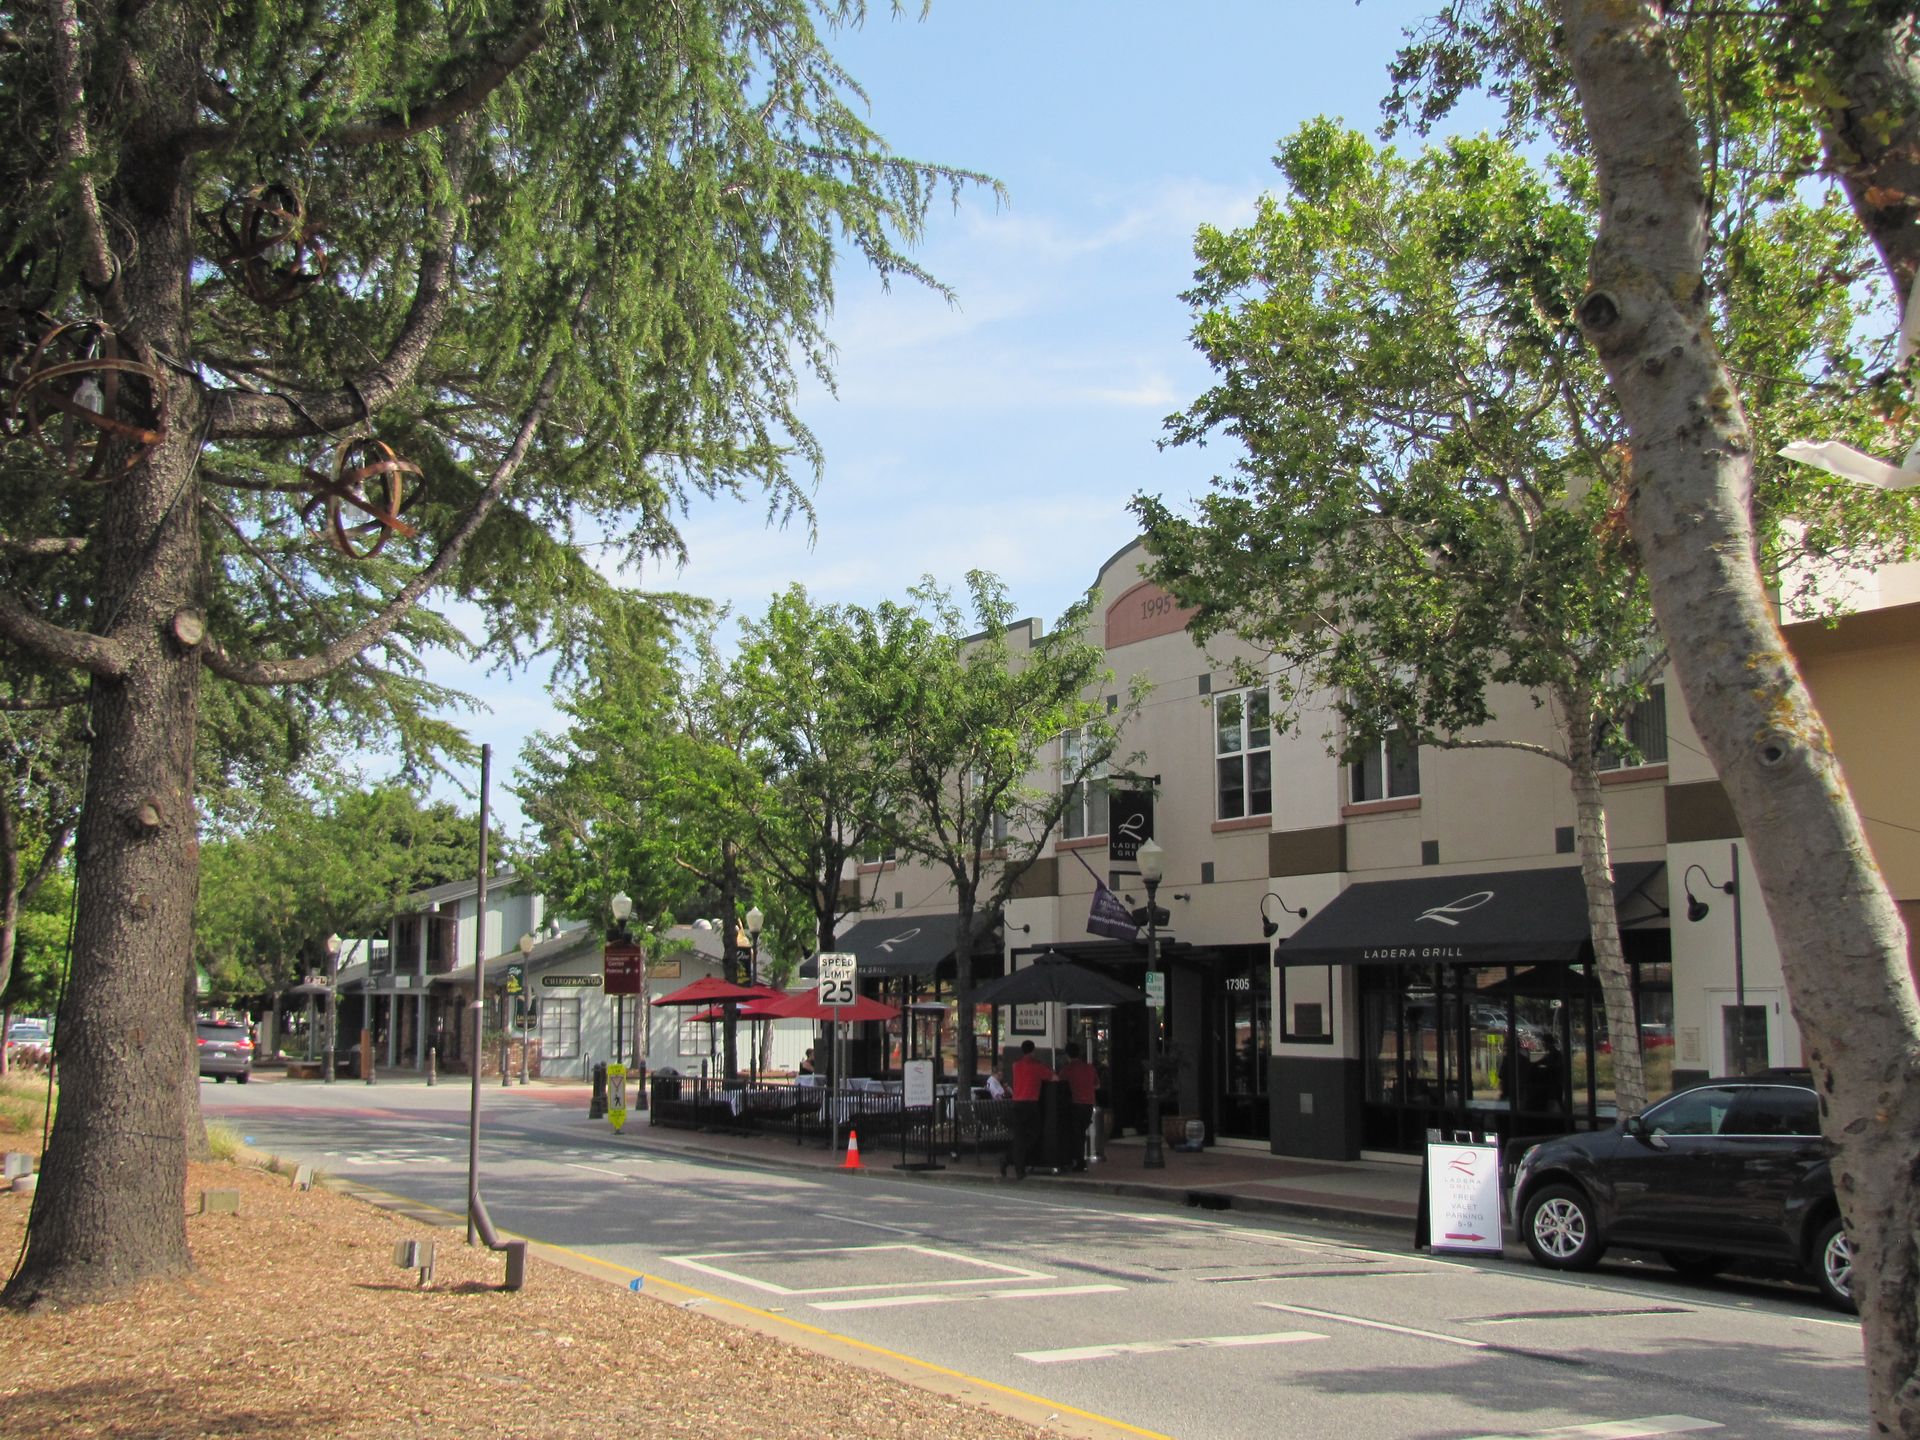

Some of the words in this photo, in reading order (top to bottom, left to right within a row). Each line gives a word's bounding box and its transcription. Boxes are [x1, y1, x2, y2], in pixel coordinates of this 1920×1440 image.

[1140, 596, 1170, 620] 1995
[1364, 949, 1416, 959] LADERA
[1422, 947, 1462, 957] GRILL
[822, 958, 854, 967] SPEED
[824, 970, 851, 979] LIMIT
[544, 977, 601, 986] CHIROPRACTOR
[1226, 978, 1250, 990] 17305
[822, 980, 853, 1003] 25
[1453, 1193, 1474, 1201] FREE
[1445, 1212, 1484, 1221] PARKING
